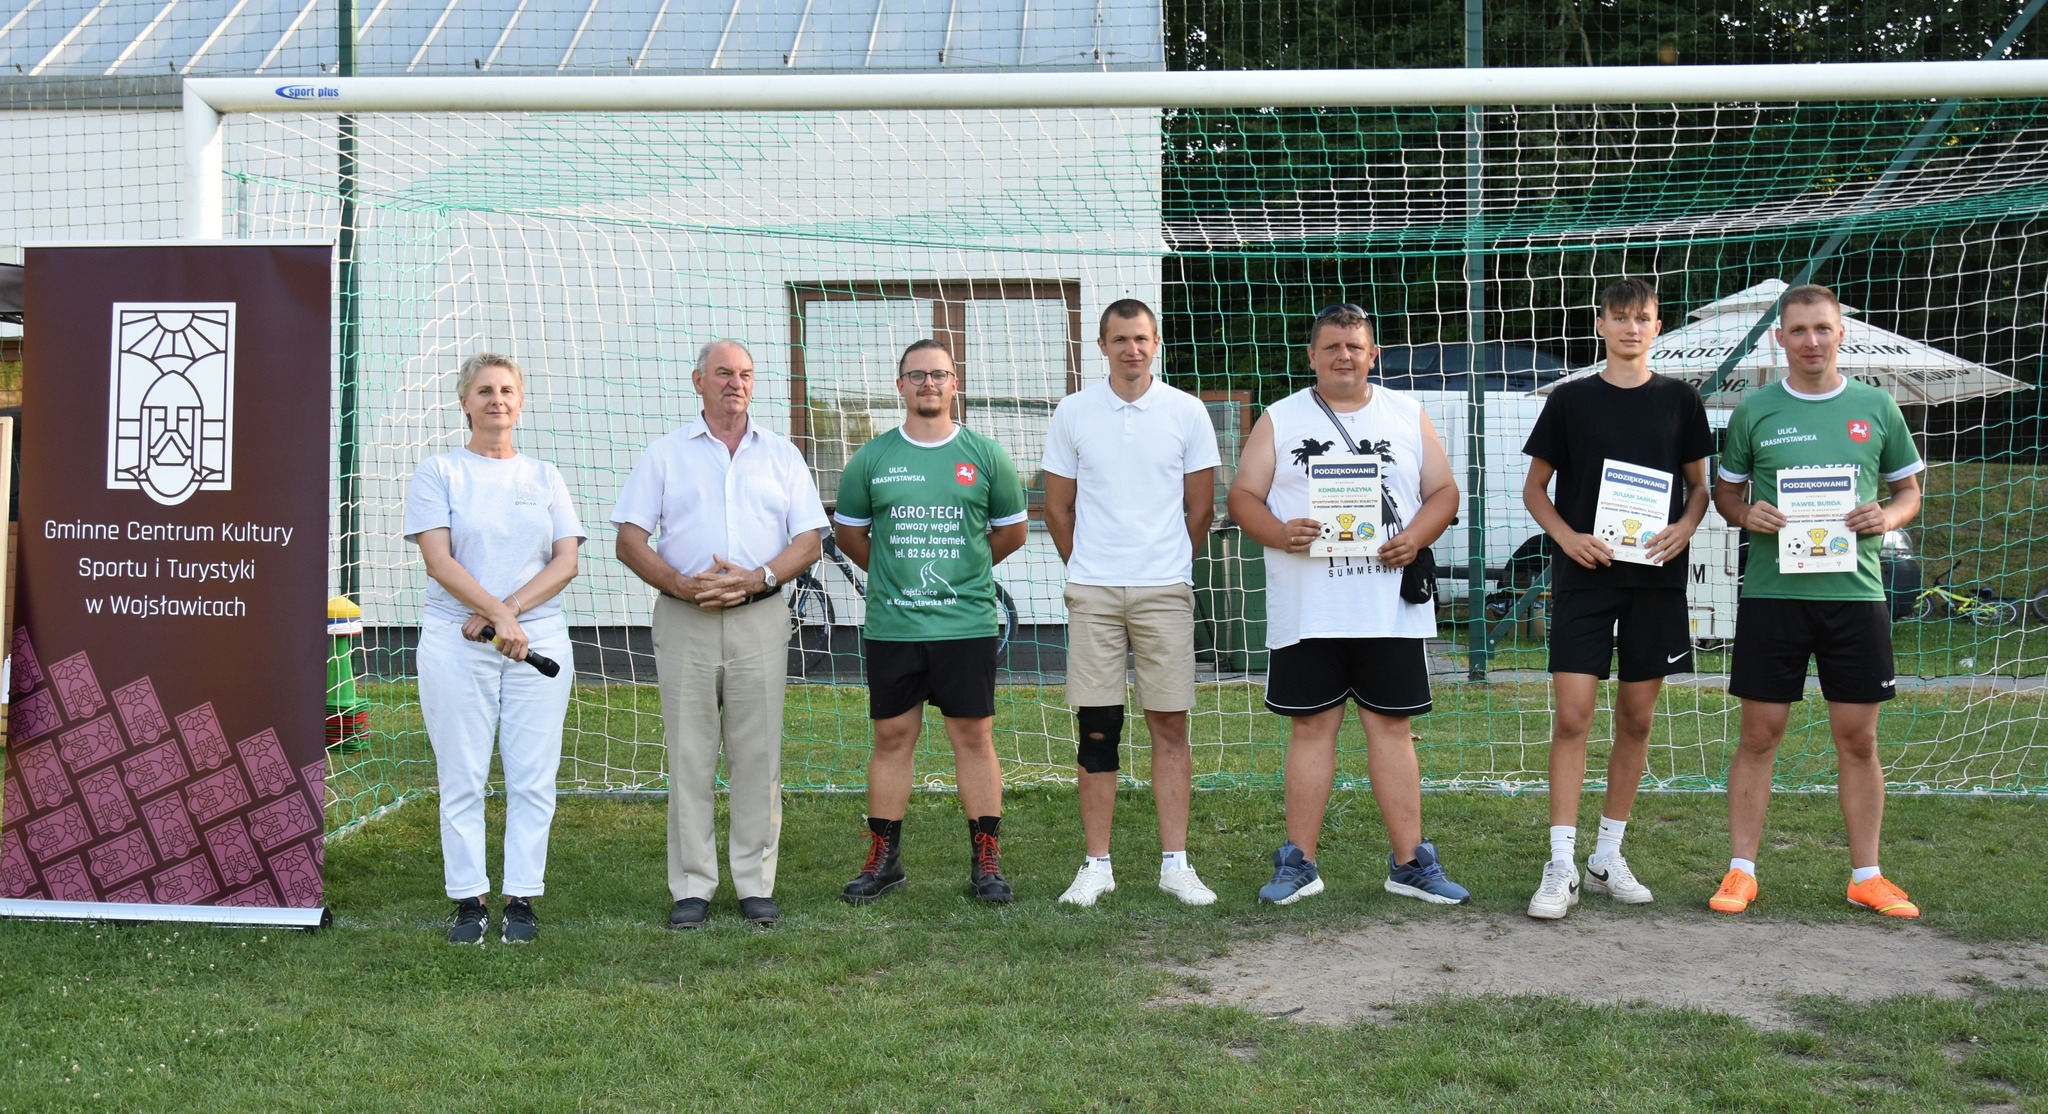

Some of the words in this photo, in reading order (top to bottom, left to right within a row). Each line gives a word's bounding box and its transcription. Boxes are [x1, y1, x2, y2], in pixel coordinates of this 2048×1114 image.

[289, 87, 314, 98] sport
[318, 87, 339, 98] plus
[1652, 344, 1758, 359] OKOCI
[1838, 344, 1911, 355] OCIM
[1777, 427, 1798, 435] ULICA
[1760, 434, 1818, 447] KRASNYSTAWSKA
[888, 466, 908, 474] ULICA
[1313, 467, 1376, 476] PODZIĘKOWANIE
[871, 474, 926, 485] KRASNYSTAWSKA
[1607, 471, 1667, 490] PODZIĘKOWANIE
[1783, 480, 1849, 490] PODZIĘKOWANIE
[890, 505, 964, 519] AGRO-TECH
[44, 519, 120, 540] Gminne
[126, 521, 214, 542] Centrum
[221, 522, 294, 546] Kultury
[895, 522, 928, 533] nawozy
[930, 521, 960, 533] węgiel
[889, 534, 926, 545] Mirosław
[928, 534, 966, 546] Jaremek
[894, 548, 905, 559] tel.
[907, 548, 918, 559] 82
[920, 549, 936, 559] 566
[938, 549, 949, 559] 92
[950, 549, 960, 559] 81
[78, 557, 147, 580] Sportu
[155, 557, 160, 578] i
[167, 559, 255, 583] Turystyki
[85, 598, 104, 614] w
[109, 595, 246, 618] Wojsławicach
[943, 598, 957, 606] 19A
